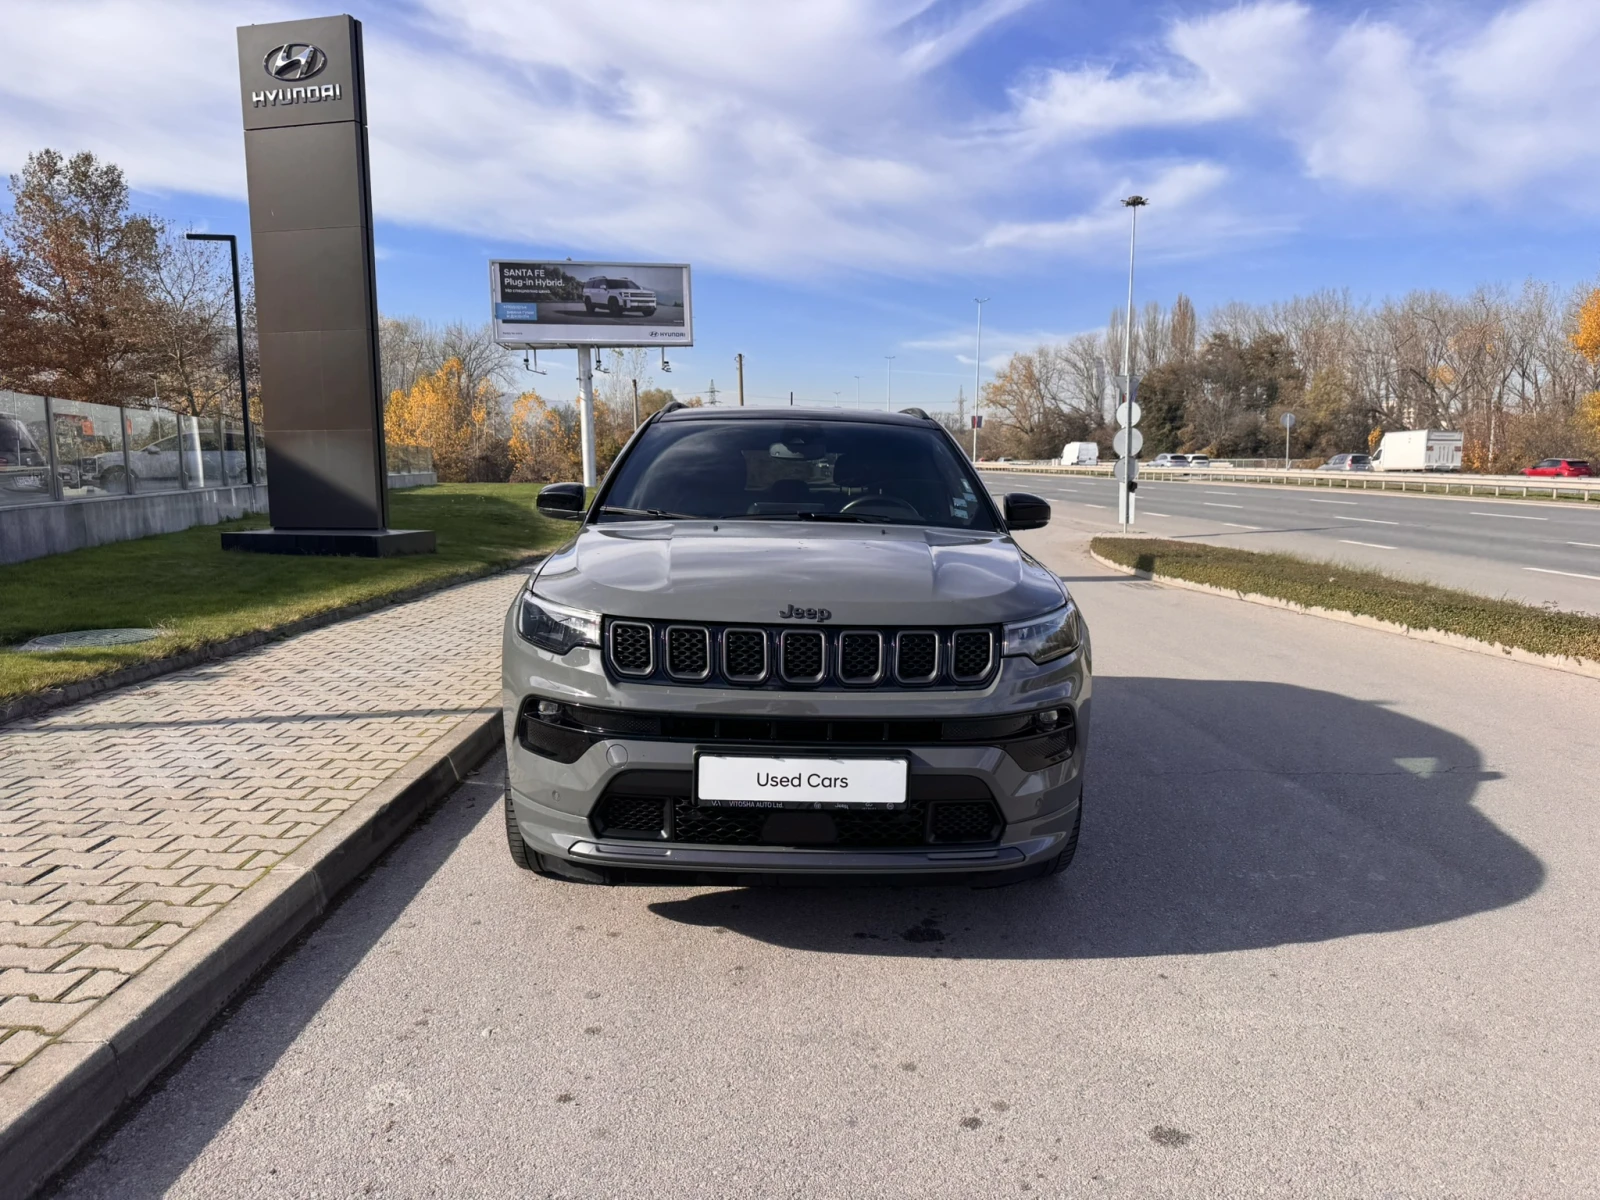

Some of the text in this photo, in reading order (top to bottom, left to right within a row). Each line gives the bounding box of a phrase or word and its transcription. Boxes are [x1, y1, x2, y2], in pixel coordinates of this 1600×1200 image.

[252, 83, 342, 108] HYUNDAI
[503, 268, 545, 277] SANTA FE
[504, 278, 565, 288] Plug-in Hybrid.
[778, 604, 832, 623] Jeep
[756, 772, 849, 788] Used Cars
[729, 800, 755, 808] VITOSHA
